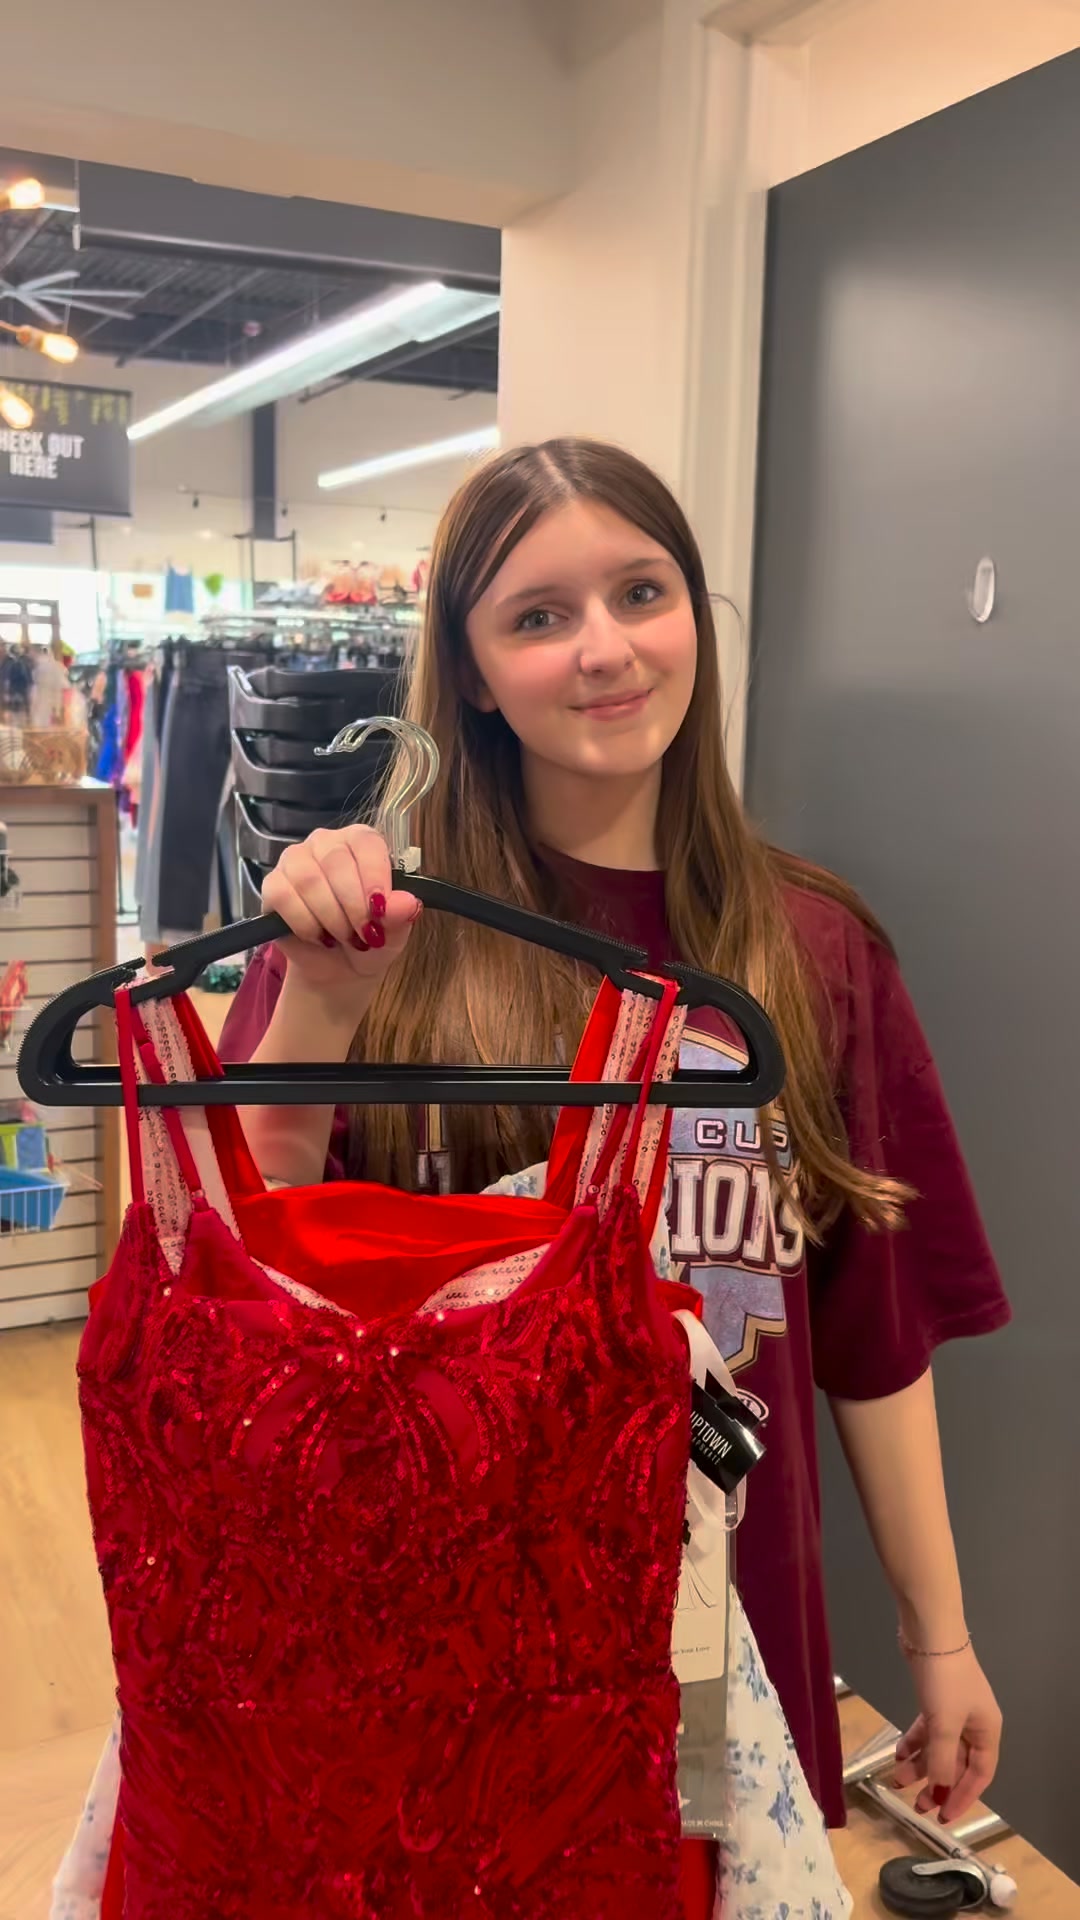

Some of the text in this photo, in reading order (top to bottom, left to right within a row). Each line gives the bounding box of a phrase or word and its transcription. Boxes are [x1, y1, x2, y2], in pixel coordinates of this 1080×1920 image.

[0, 430, 84, 459] HECK OUT
[10, 453, 58, 479] HERE
[669, 1158, 804, 1268] IONS
[689, 1410, 733, 1459] UPTOWN
